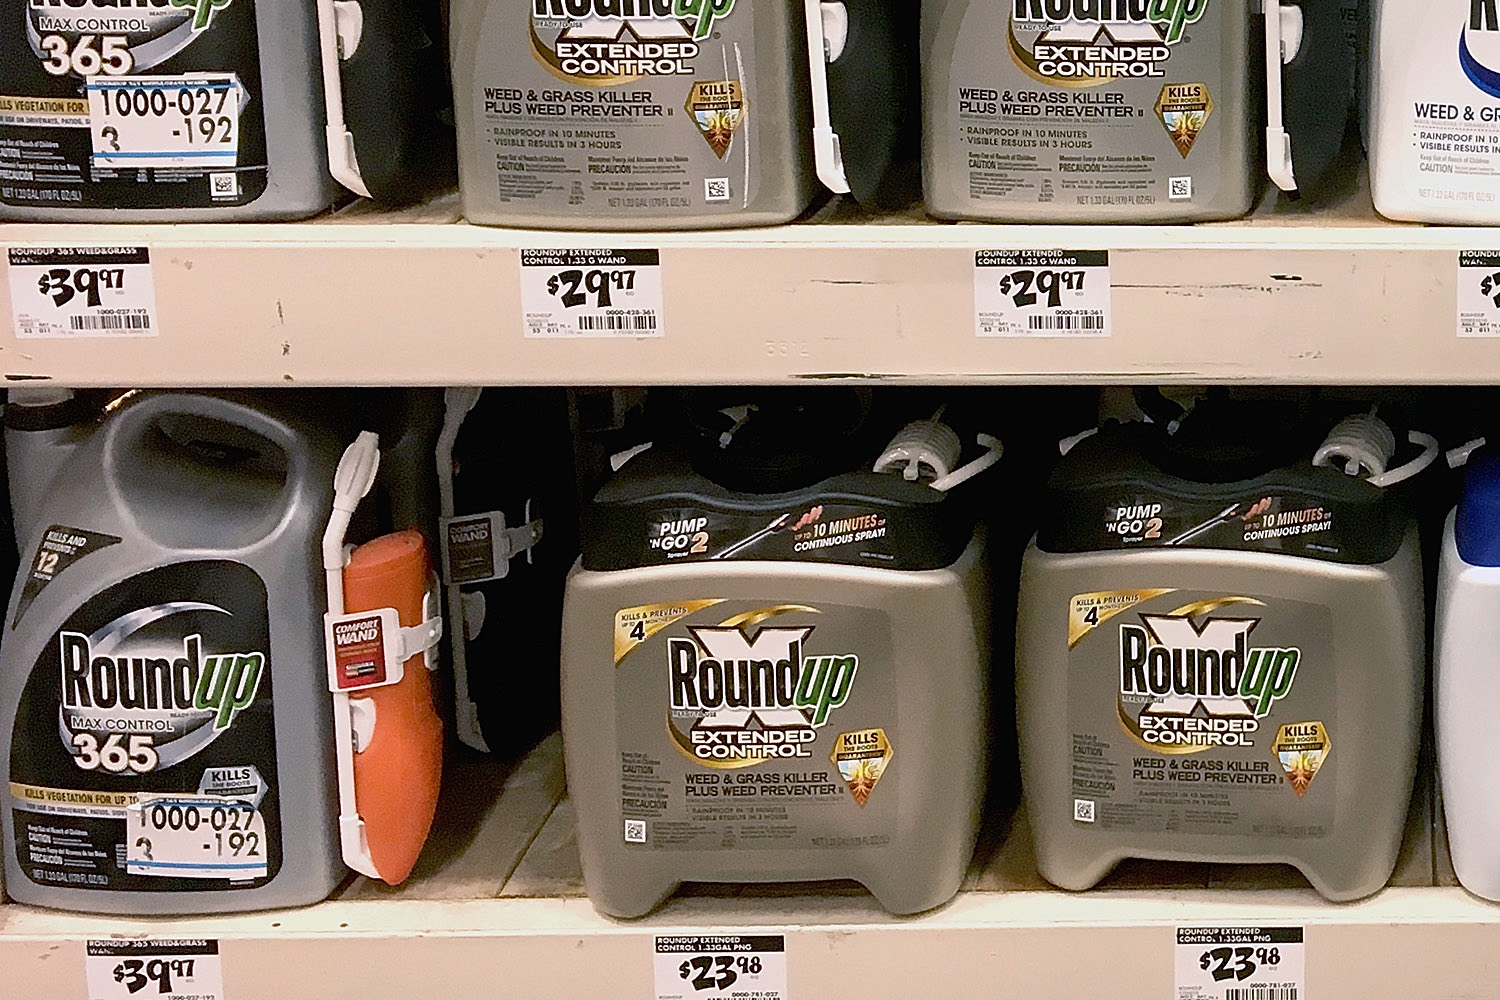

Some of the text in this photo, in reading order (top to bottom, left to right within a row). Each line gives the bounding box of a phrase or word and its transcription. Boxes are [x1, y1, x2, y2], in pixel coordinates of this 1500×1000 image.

[40, 17, 148, 31] MAX CONTROL
[42, 38, 134, 73] 365
[557, 43, 699, 59] EXTENDED
[1035, 46, 1170, 61] EXTENDED
[562, 59, 694, 74] CONTROL
[1039, 62, 1165, 76] CONTROL
[101, 87, 230, 115] 1000-027
[1415, 104, 1460, 120] WEED
[1464, 105, 1476, 121] &
[968, 127, 1088, 139] RAINPROOF IN 10 MINUTES
[967, 137, 1093, 149] VISIBLE RESULTS IN 3 HOURS
[660, 517, 707, 535] PUMP
[814, 516, 877, 536] 10 MINUTES
[650, 533, 708, 551] 'N GO 2
[794, 528, 885, 551] CONTINUOUS SPRAY!
[336, 621, 377, 633] COMFORT
[337, 629, 377, 642] WAND
[1121, 625, 1299, 716] Roundup
[62, 633, 263, 730] Roundup
[670, 639, 857, 726] Roundup
[72, 717, 173, 730] MAX CONTROL
[692, 730, 815, 745] EXTENDED
[73, 736, 157, 770] 365
[695, 744, 811, 758] CONTROL
[211, 769, 250, 782] KILLS
[24, 788, 126, 803] KILLS VEGETATION FOR UP
